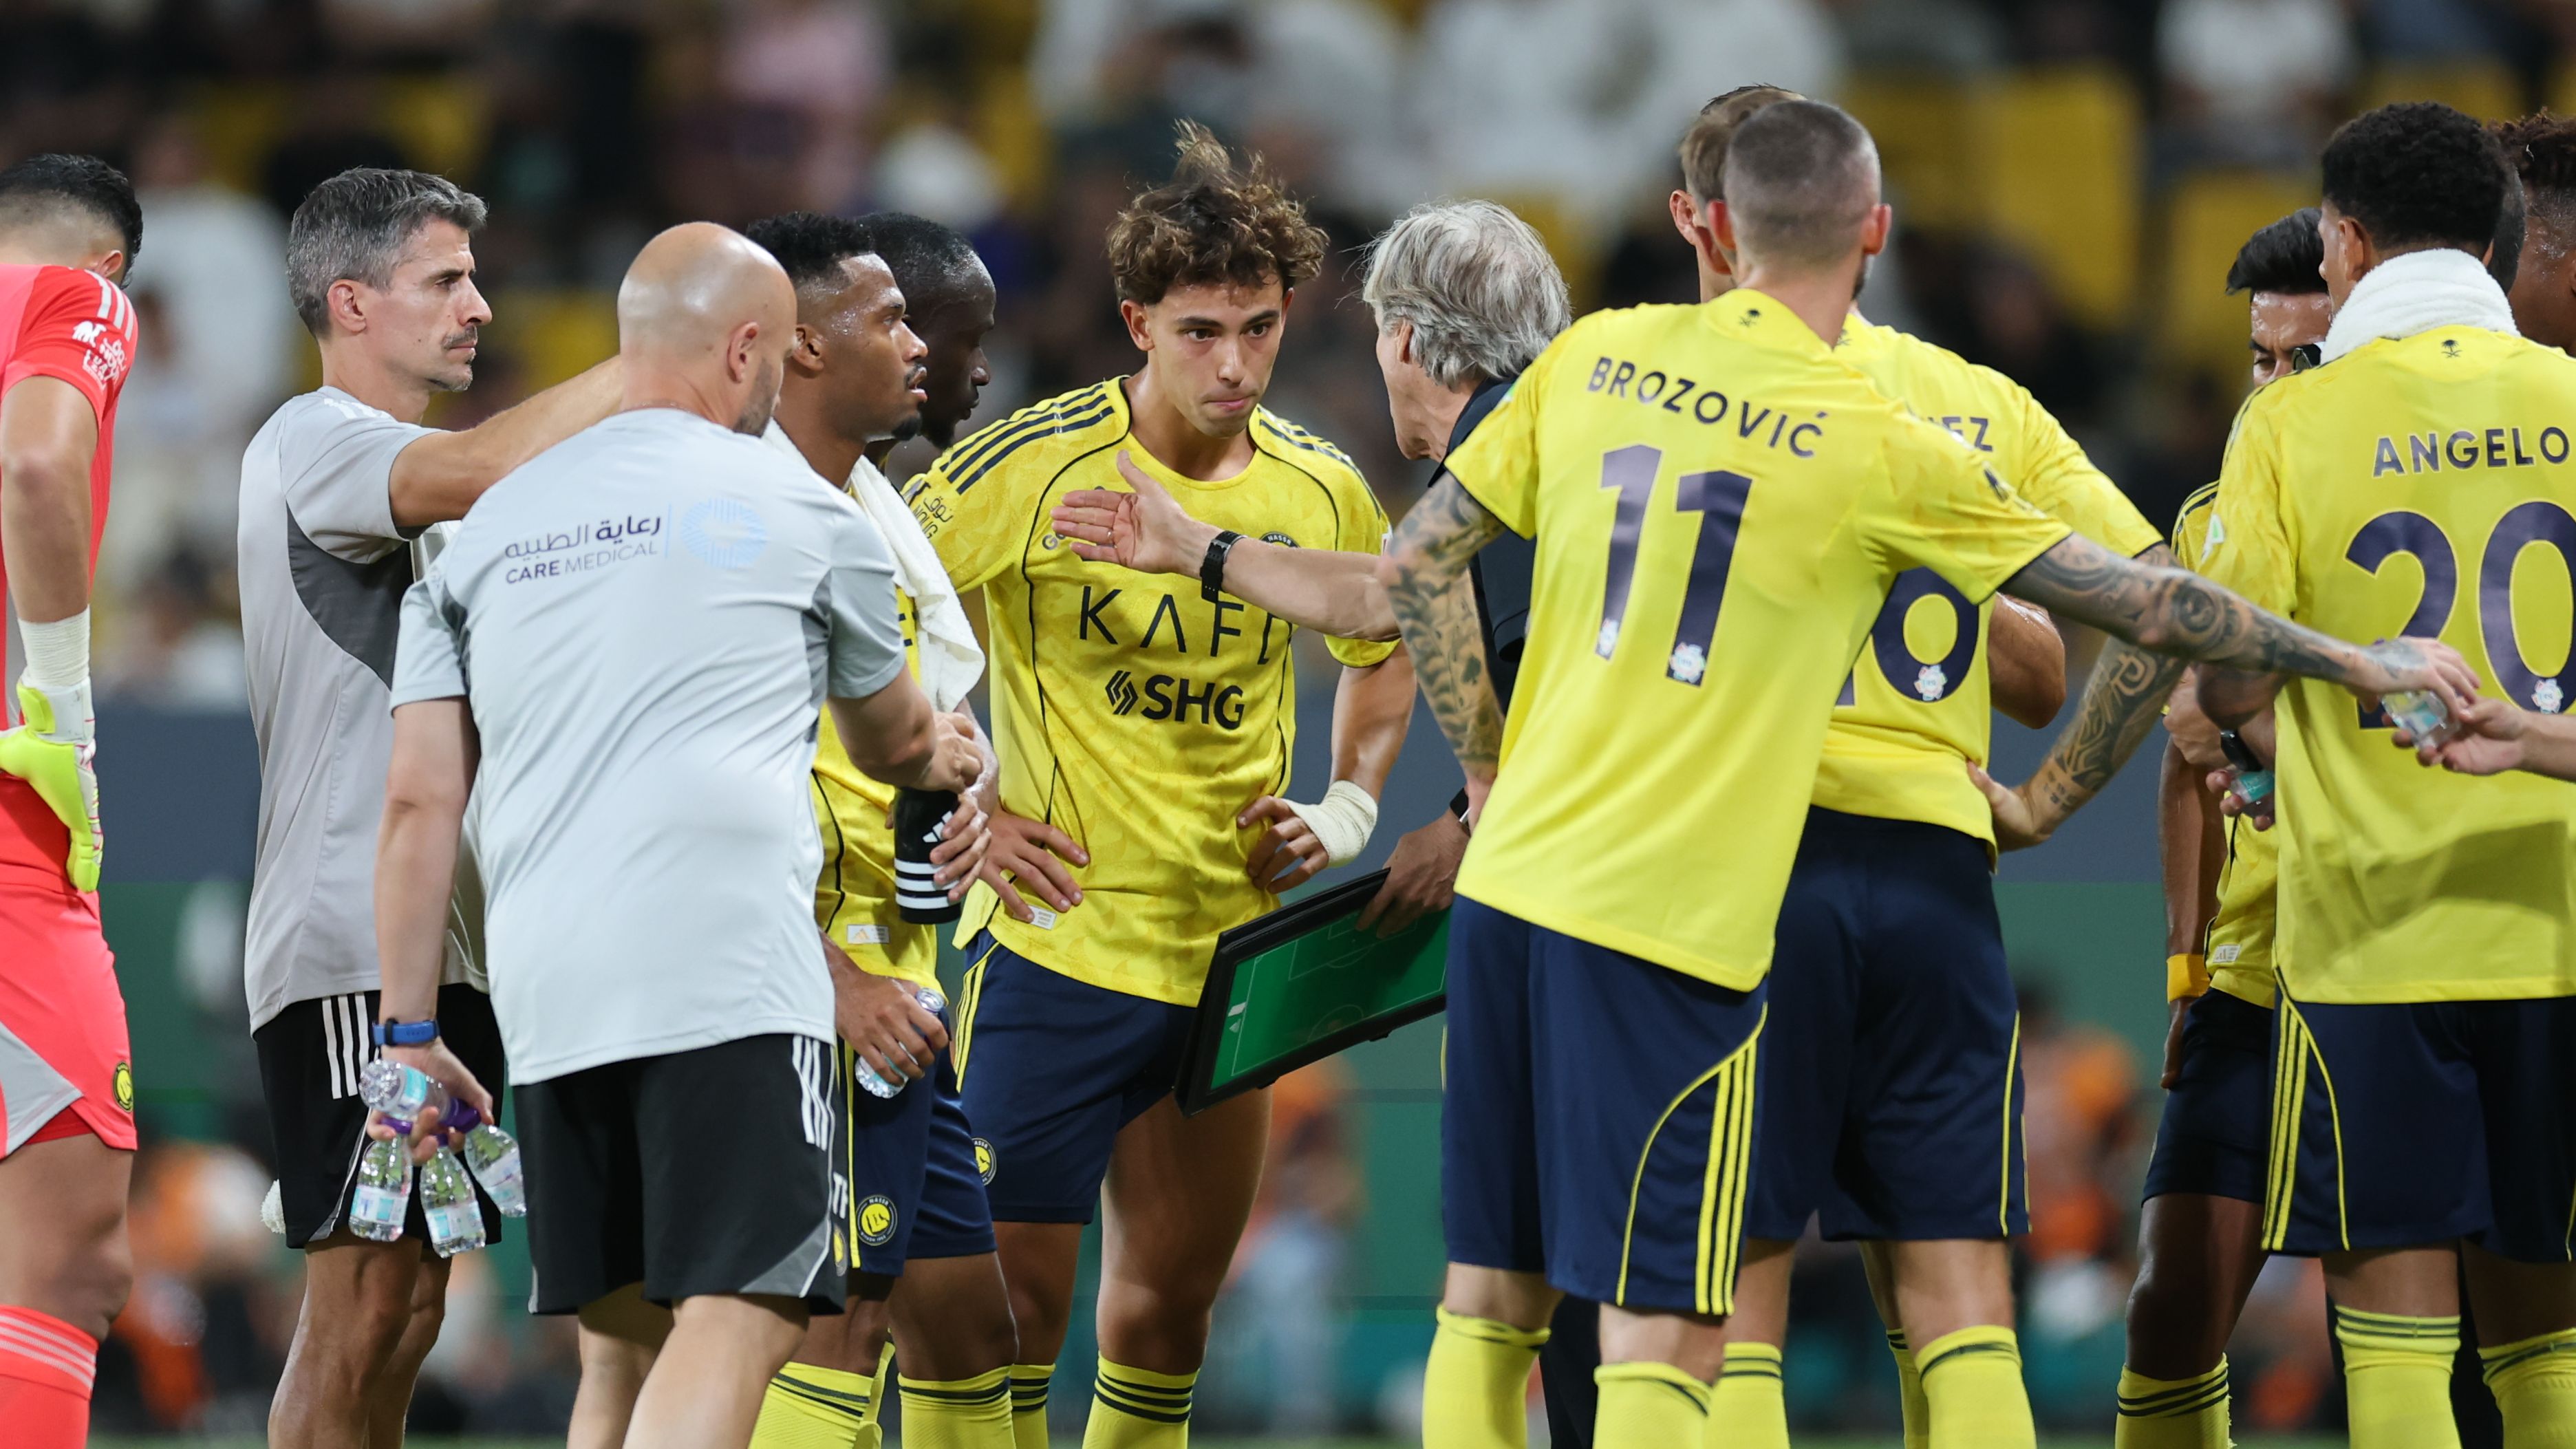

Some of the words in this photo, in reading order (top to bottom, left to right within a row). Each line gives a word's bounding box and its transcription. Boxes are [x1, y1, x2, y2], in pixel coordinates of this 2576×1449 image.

[1587, 356, 1828, 459] BROZOVIĆ
[2372, 426, 2571, 477] ANGELO
[595, 515, 662, 545] رعاية
[506, 559, 560, 584] CARE
[564, 541, 658, 574] MEDICAL
[1595, 444, 1753, 687] 11
[2345, 502, 2576, 729] 20
[1141, 674, 1245, 730] SHG
